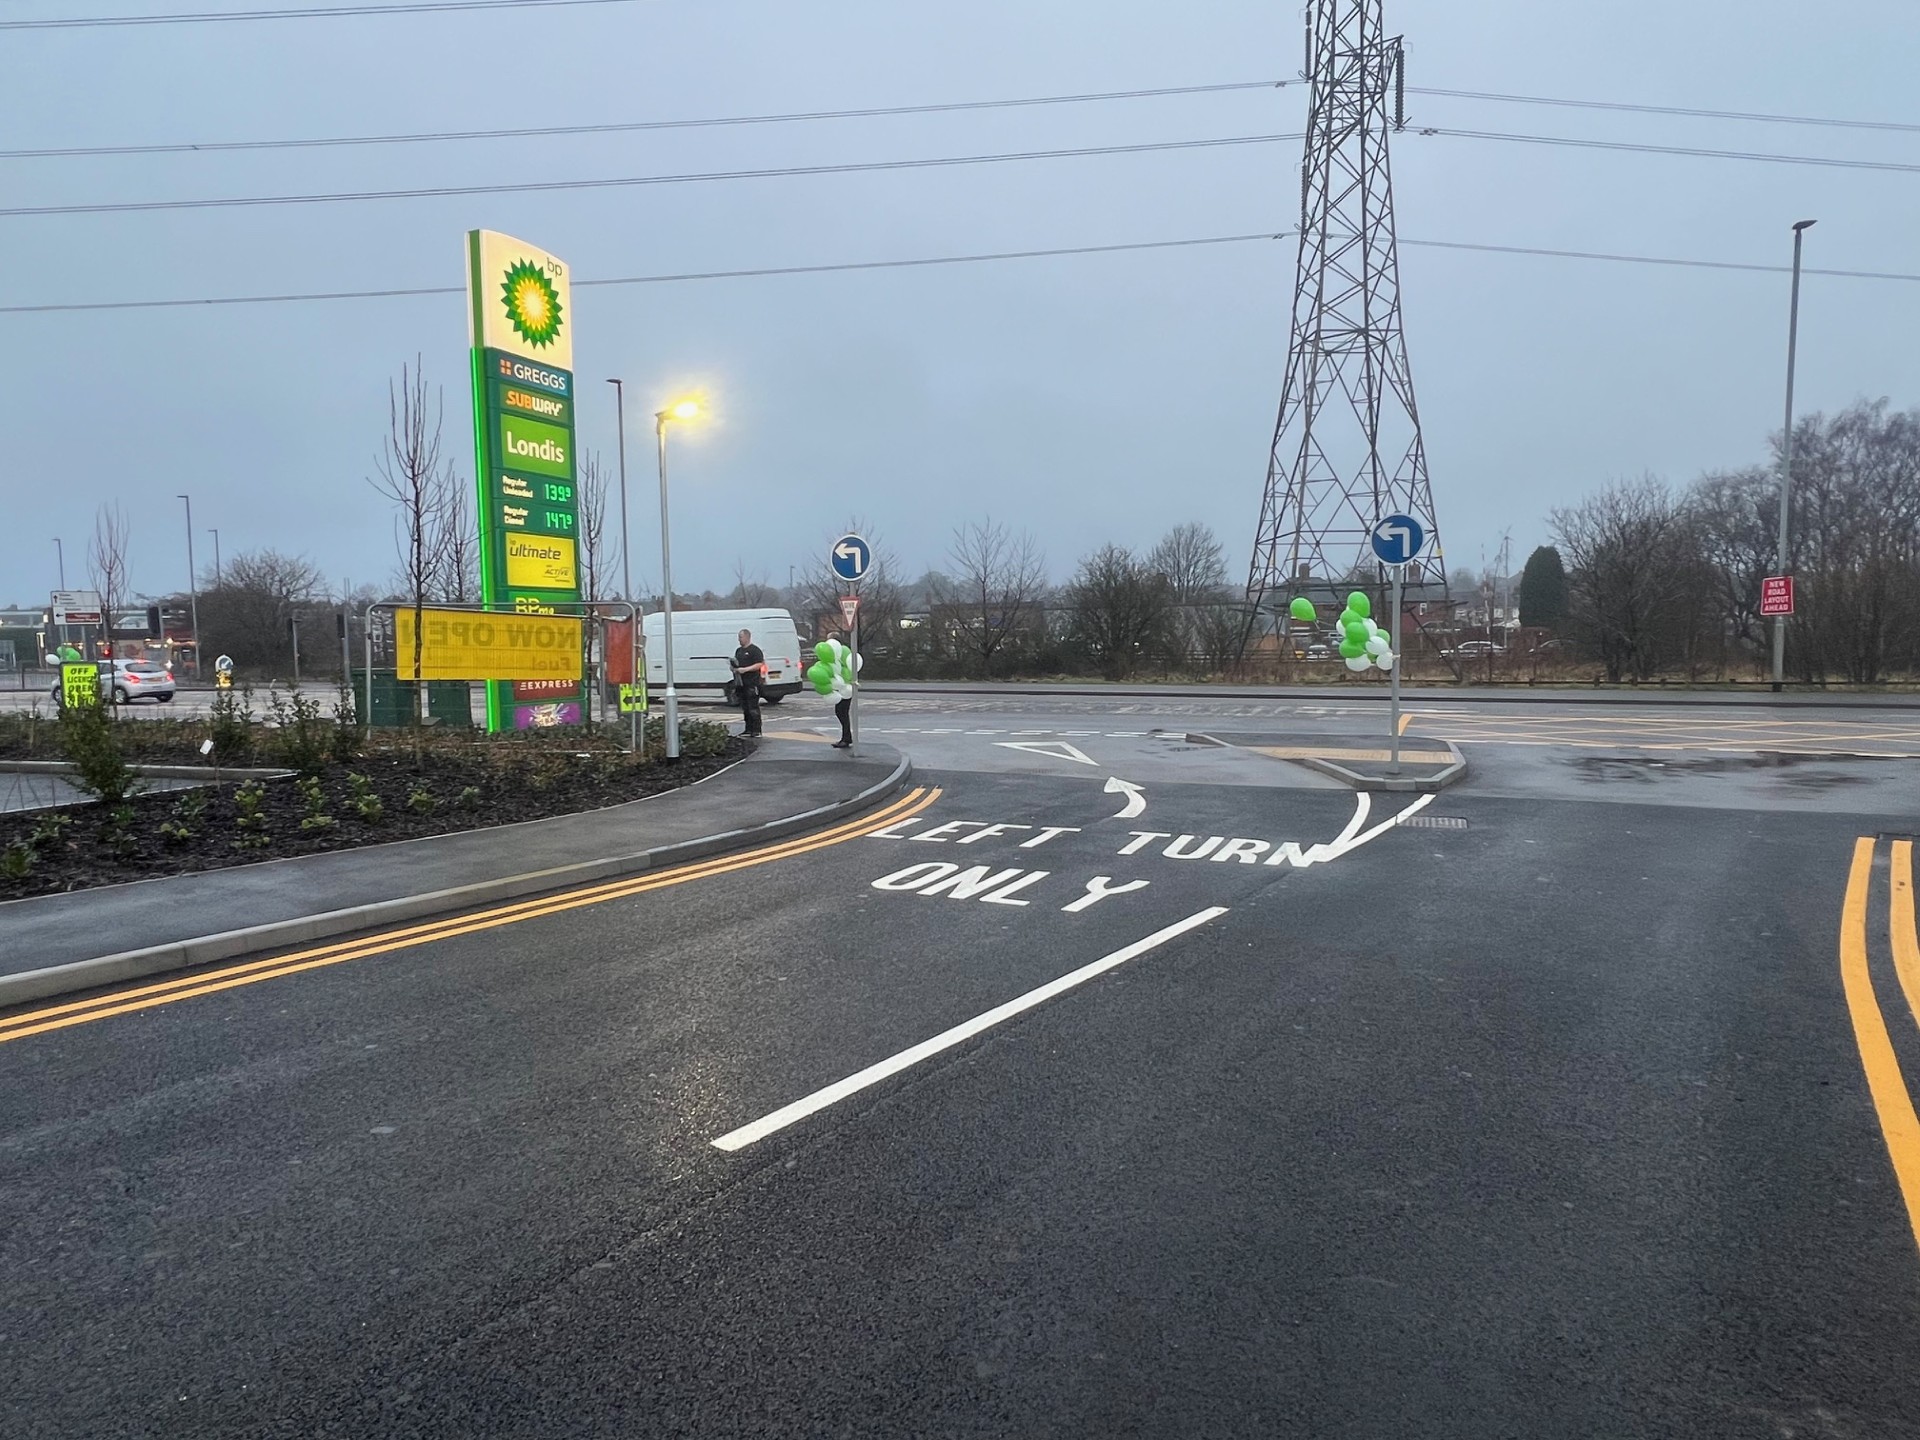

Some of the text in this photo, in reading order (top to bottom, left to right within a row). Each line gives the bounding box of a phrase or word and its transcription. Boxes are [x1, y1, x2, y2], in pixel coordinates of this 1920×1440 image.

[546, 257, 563, 277] bp
[513, 363, 566, 390] GREGGS
[505, 390, 563, 417] SUBWAY
[506, 431, 565, 463] Londis
[509, 543, 562, 560] ultimate
[1767, 587, 1786, 596] ROAD
[1769, 580, 1785, 588] NEW
[1764, 595, 1790, 604] LAYOUT
[1764, 603, 1789, 611] AHEAD
[70, 667, 89, 675] OFF
[527, 679, 574, 690] EXPRESS
[865, 817, 1335, 868] LEFT TURN
[870, 862, 1150, 913] ONLY
